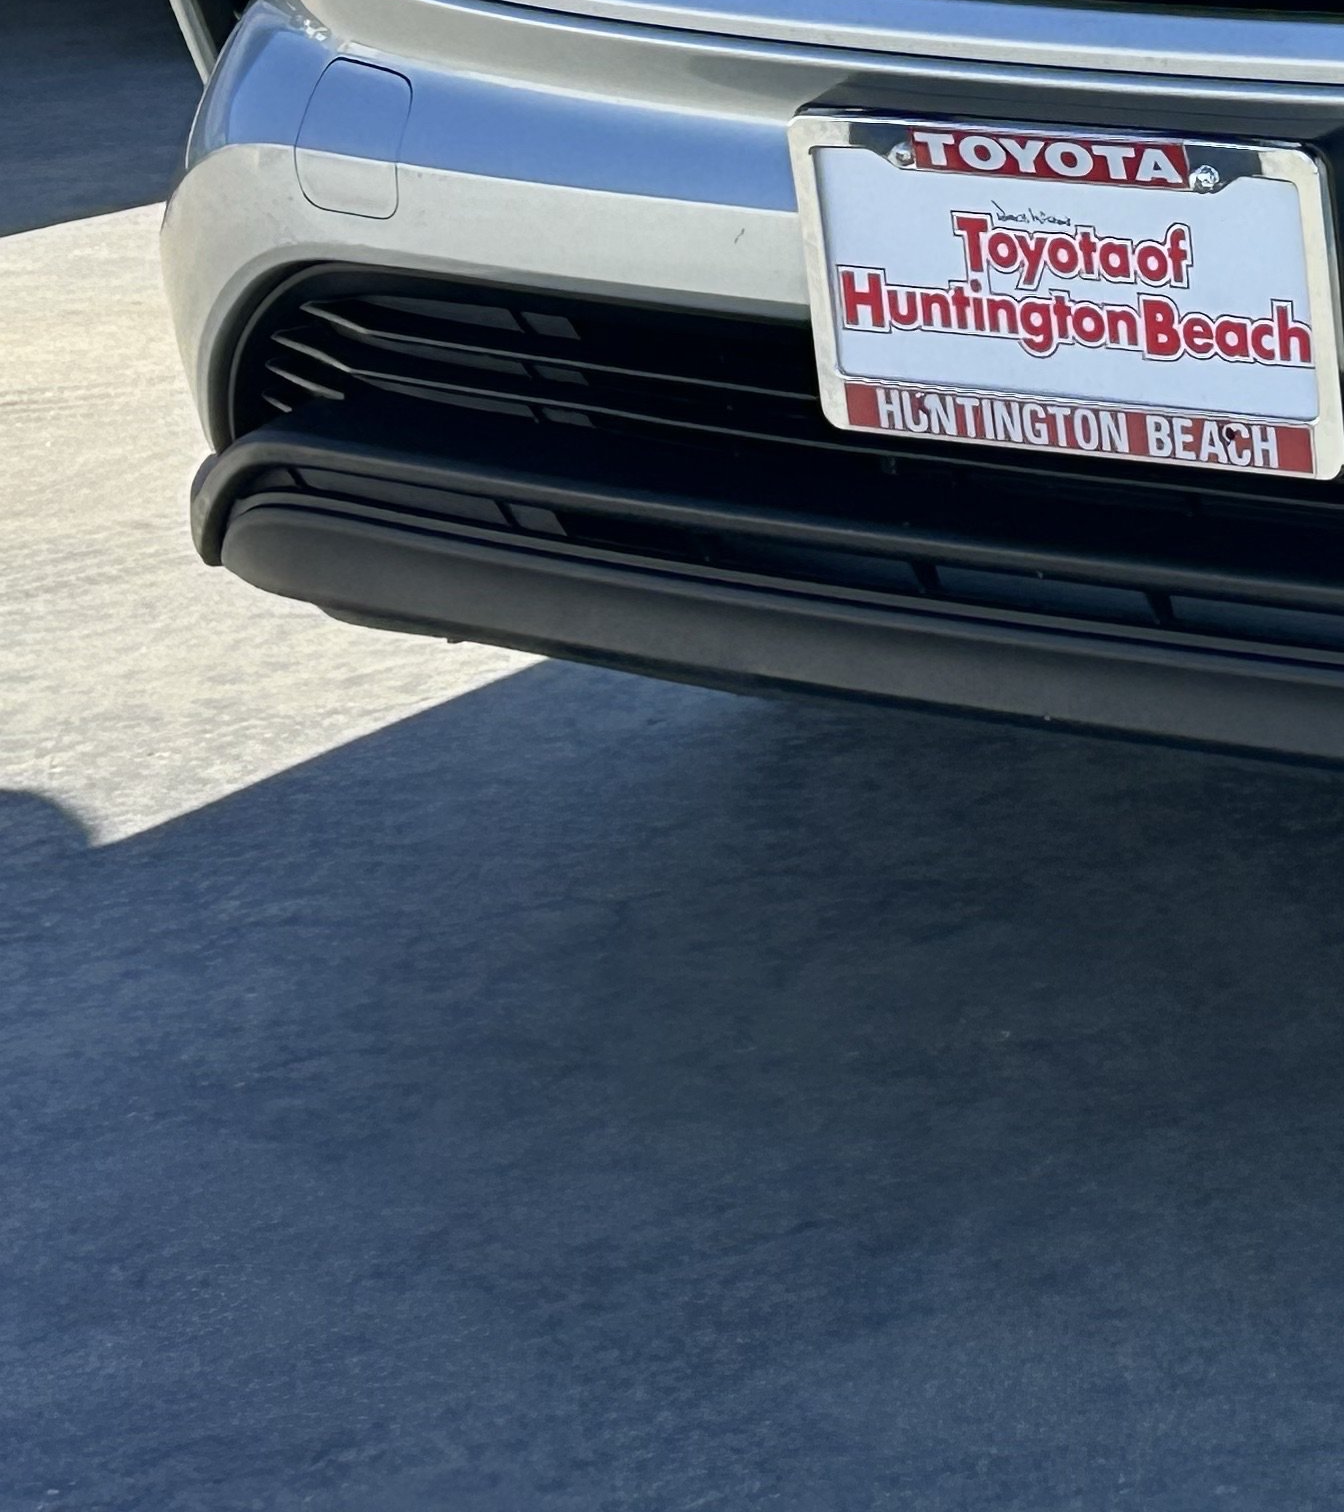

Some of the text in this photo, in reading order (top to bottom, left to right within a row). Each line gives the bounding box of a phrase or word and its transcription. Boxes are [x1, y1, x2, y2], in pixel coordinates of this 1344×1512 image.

[912, 130, 1184, 184] TOYOTA
[876, 387, 1280, 469] HUNTINGTON BEACH
